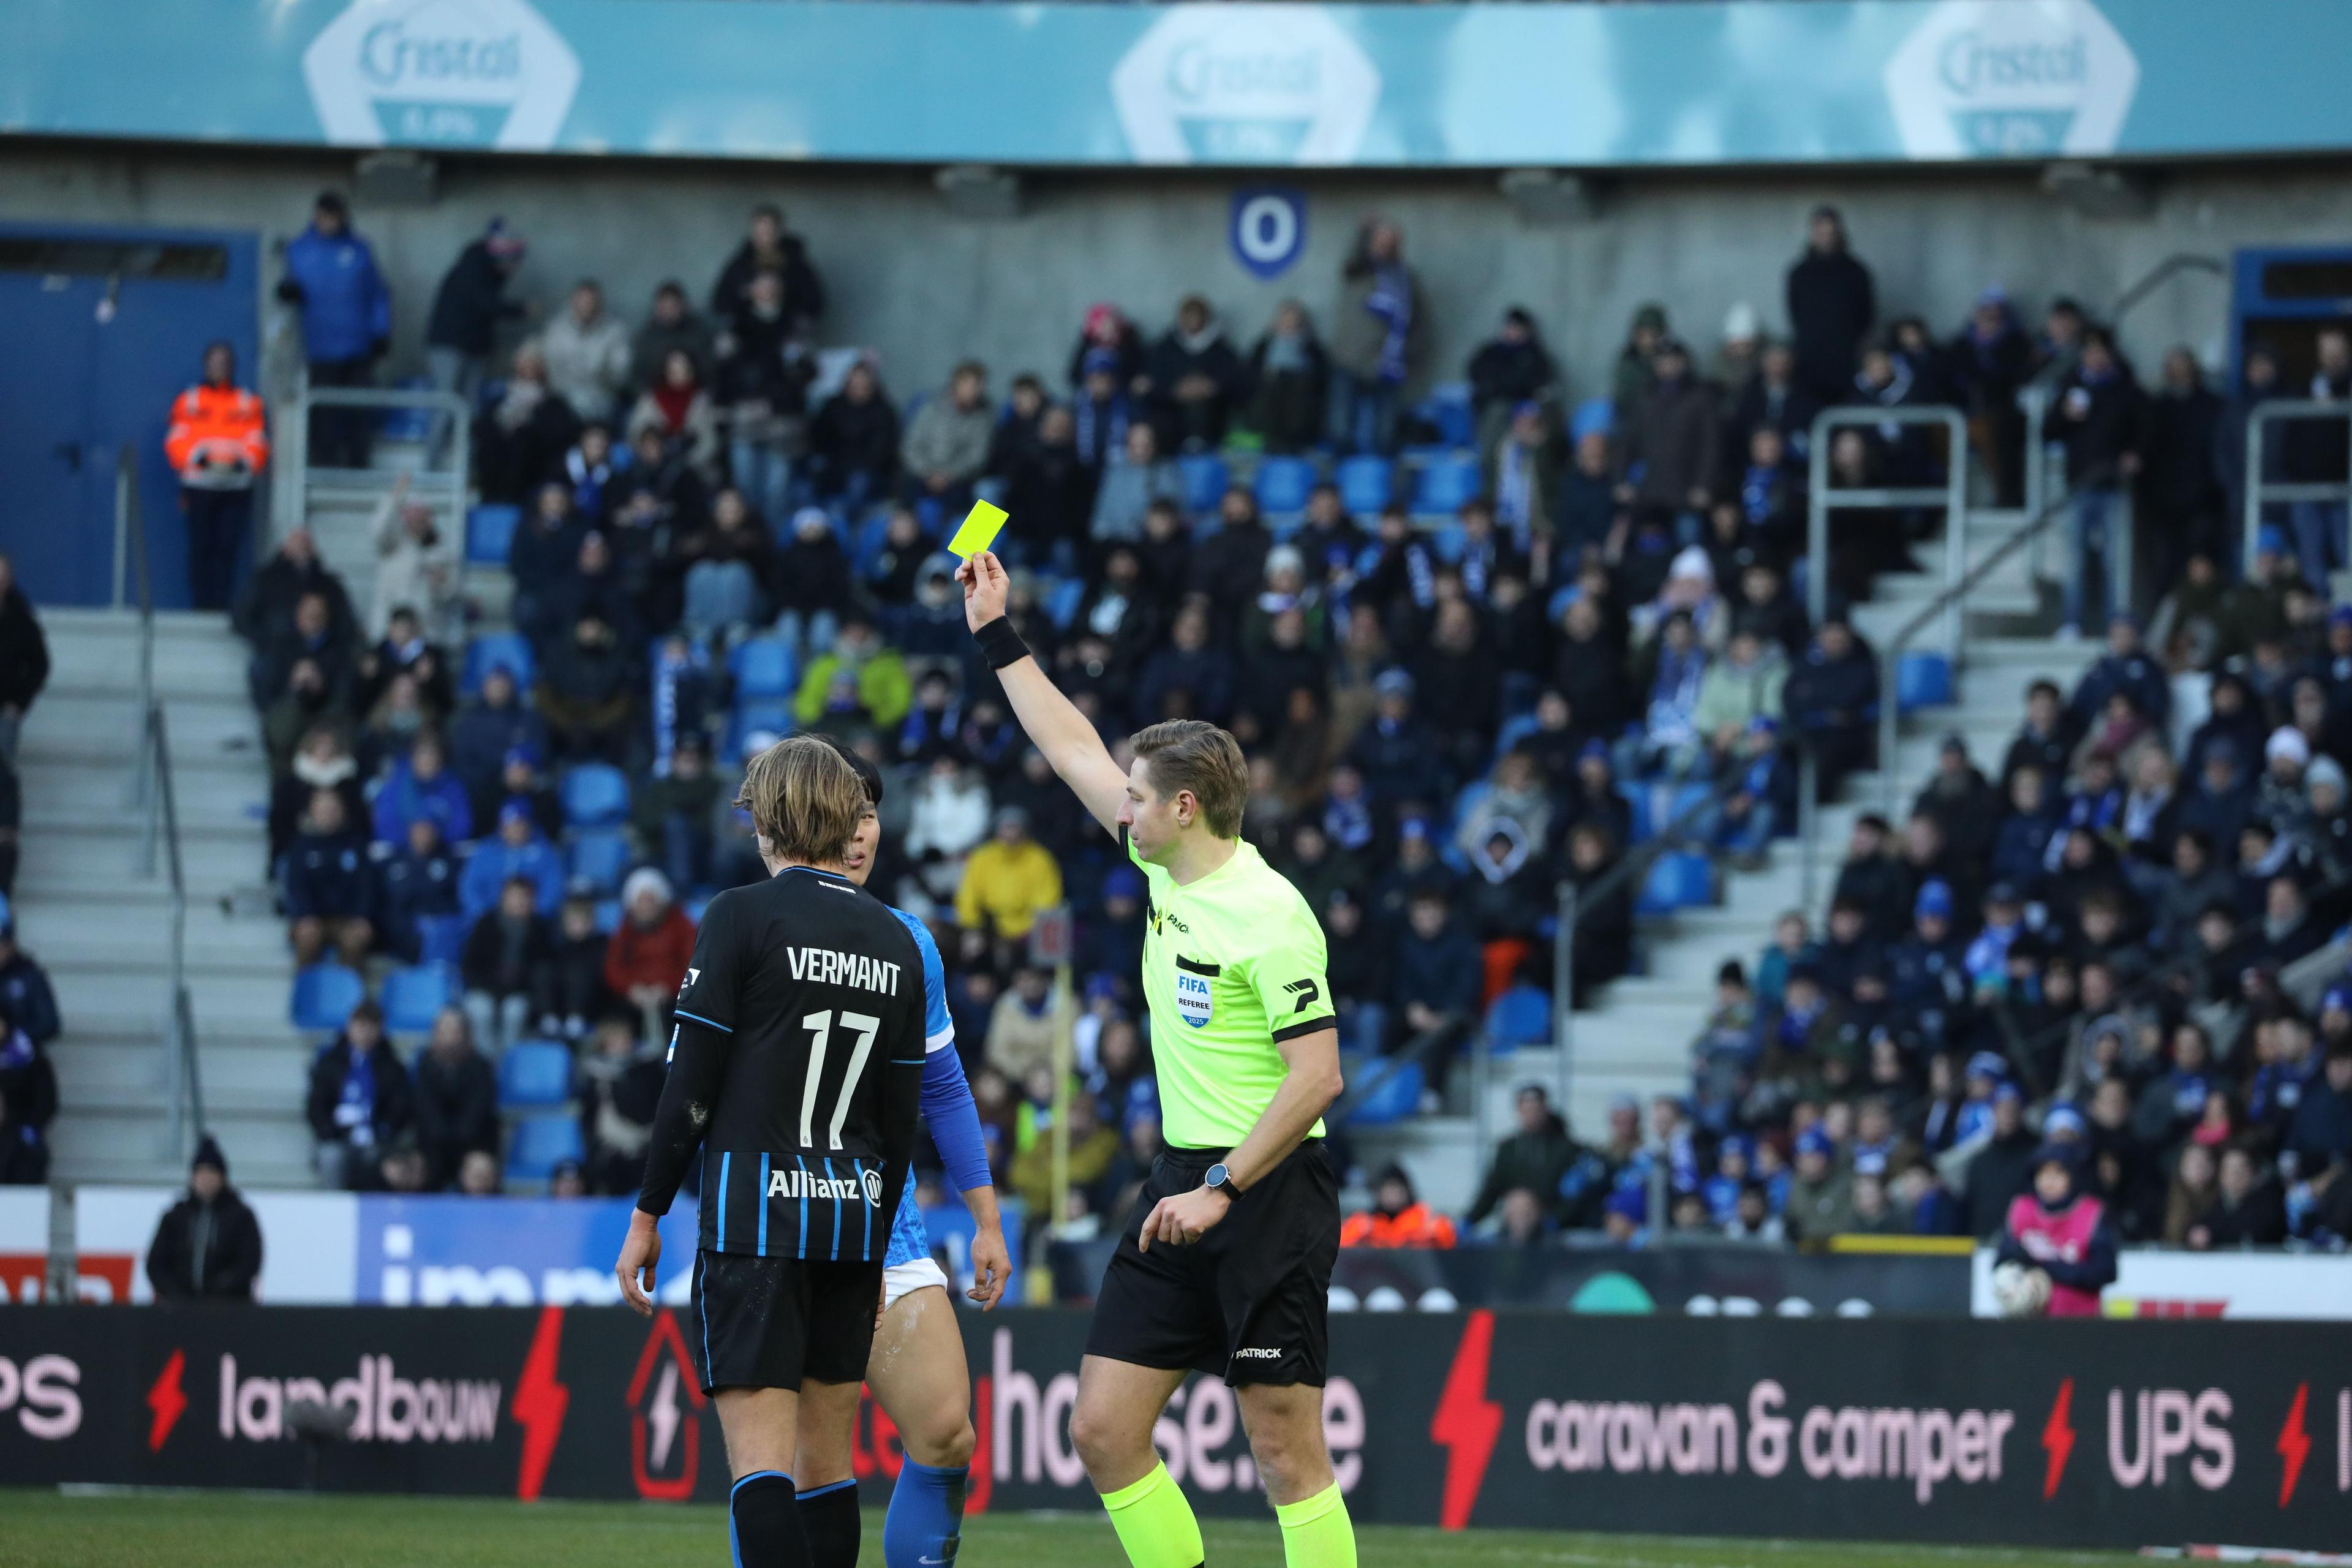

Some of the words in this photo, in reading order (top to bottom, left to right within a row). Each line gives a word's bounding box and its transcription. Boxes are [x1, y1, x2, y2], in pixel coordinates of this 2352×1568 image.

[787, 947, 900, 997] VERMANT
[1179, 975, 1208, 995] FIFA
[1178, 998, 1210, 1010] REFEREE
[800, 1009, 880, 1150] 17
[767, 1170, 860, 1199] Allianz
[1236, 1348, 1282, 1359] PATRICK
[1526, 1398, 1739, 1475] caravan
[1746, 1378, 1792, 1478] &
[1799, 1404, 2015, 1506] camper
[2107, 1385, 2236, 1491] UPS
